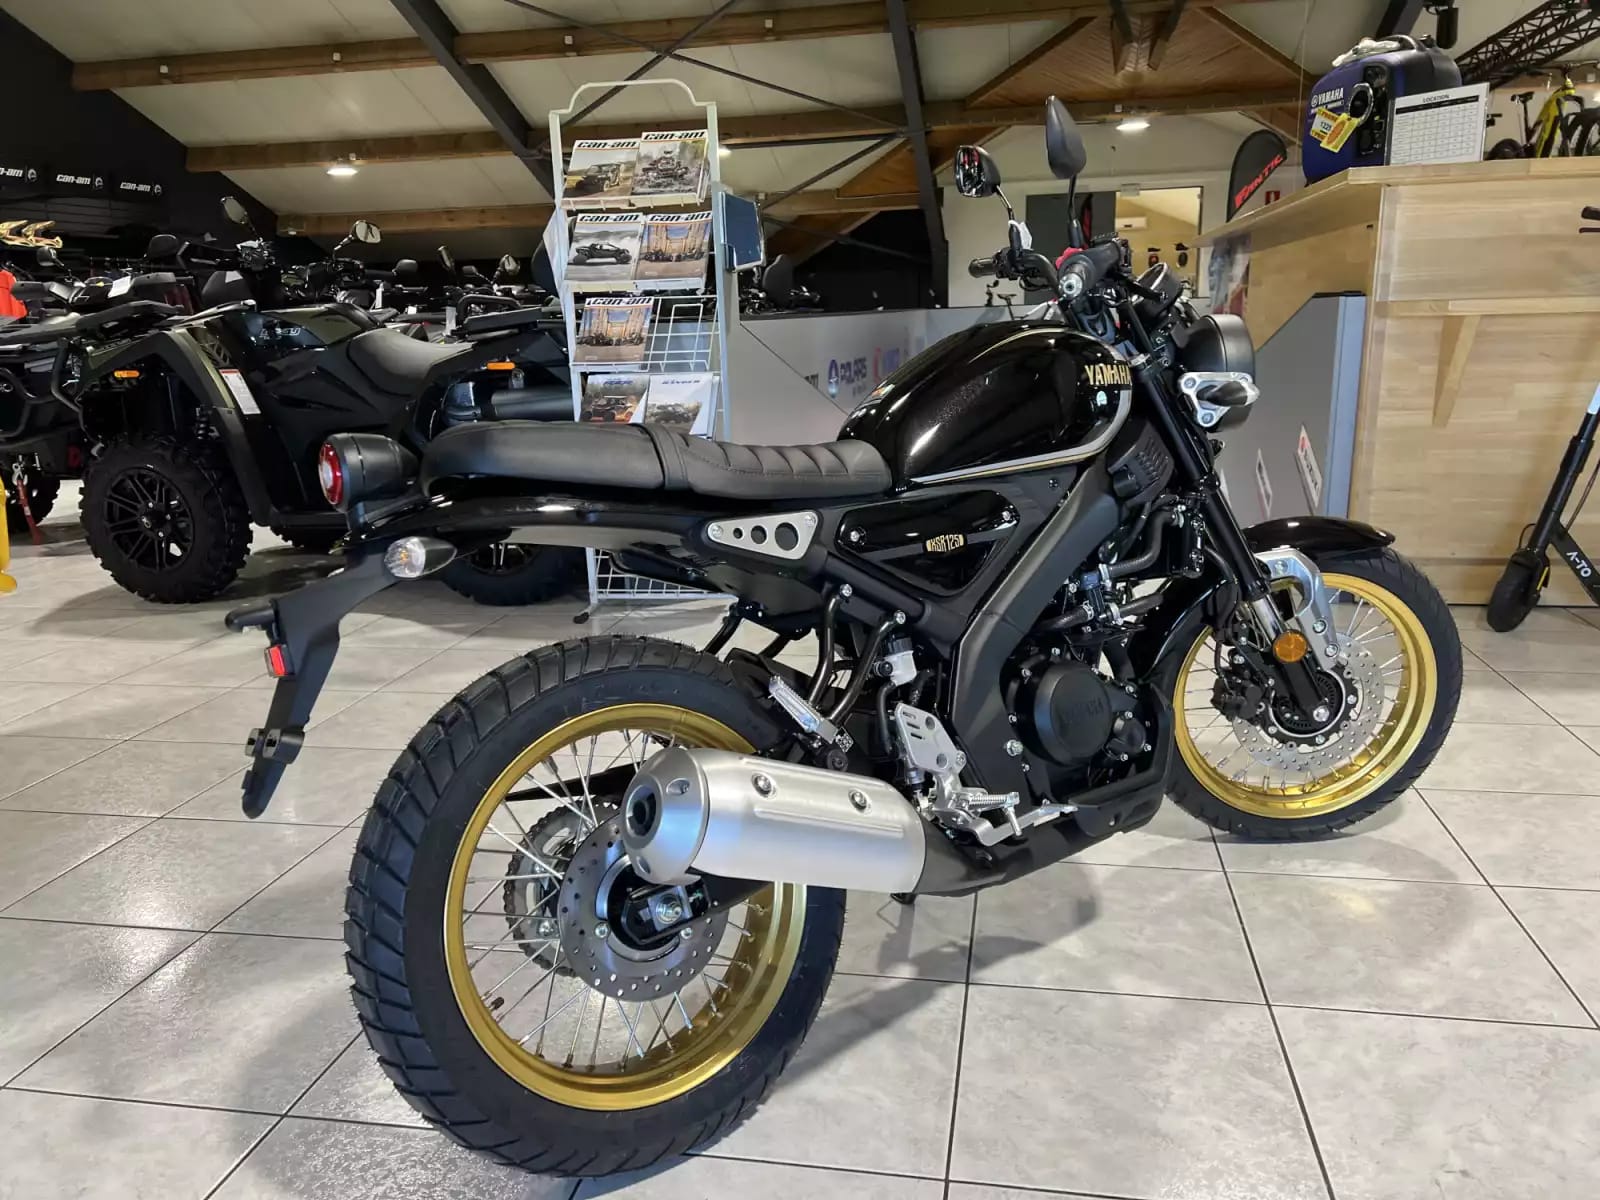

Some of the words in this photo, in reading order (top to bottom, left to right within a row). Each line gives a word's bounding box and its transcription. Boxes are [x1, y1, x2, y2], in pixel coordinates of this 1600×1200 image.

[1318, 87, 1344, 105] YAMAHA
[643, 131, 705, 140] can-am
[577, 140, 637, 148] can-am
[0, 167, 23, 177] n-am
[56, 173, 91, 184] can-am
[120, 181, 151, 192] can-am
[579, 214, 640, 222] can-am
[649, 212, 711, 222] can-am
[1084, 364, 1132, 386] YAMAHA
[930, 534, 960, 552] XSR125
